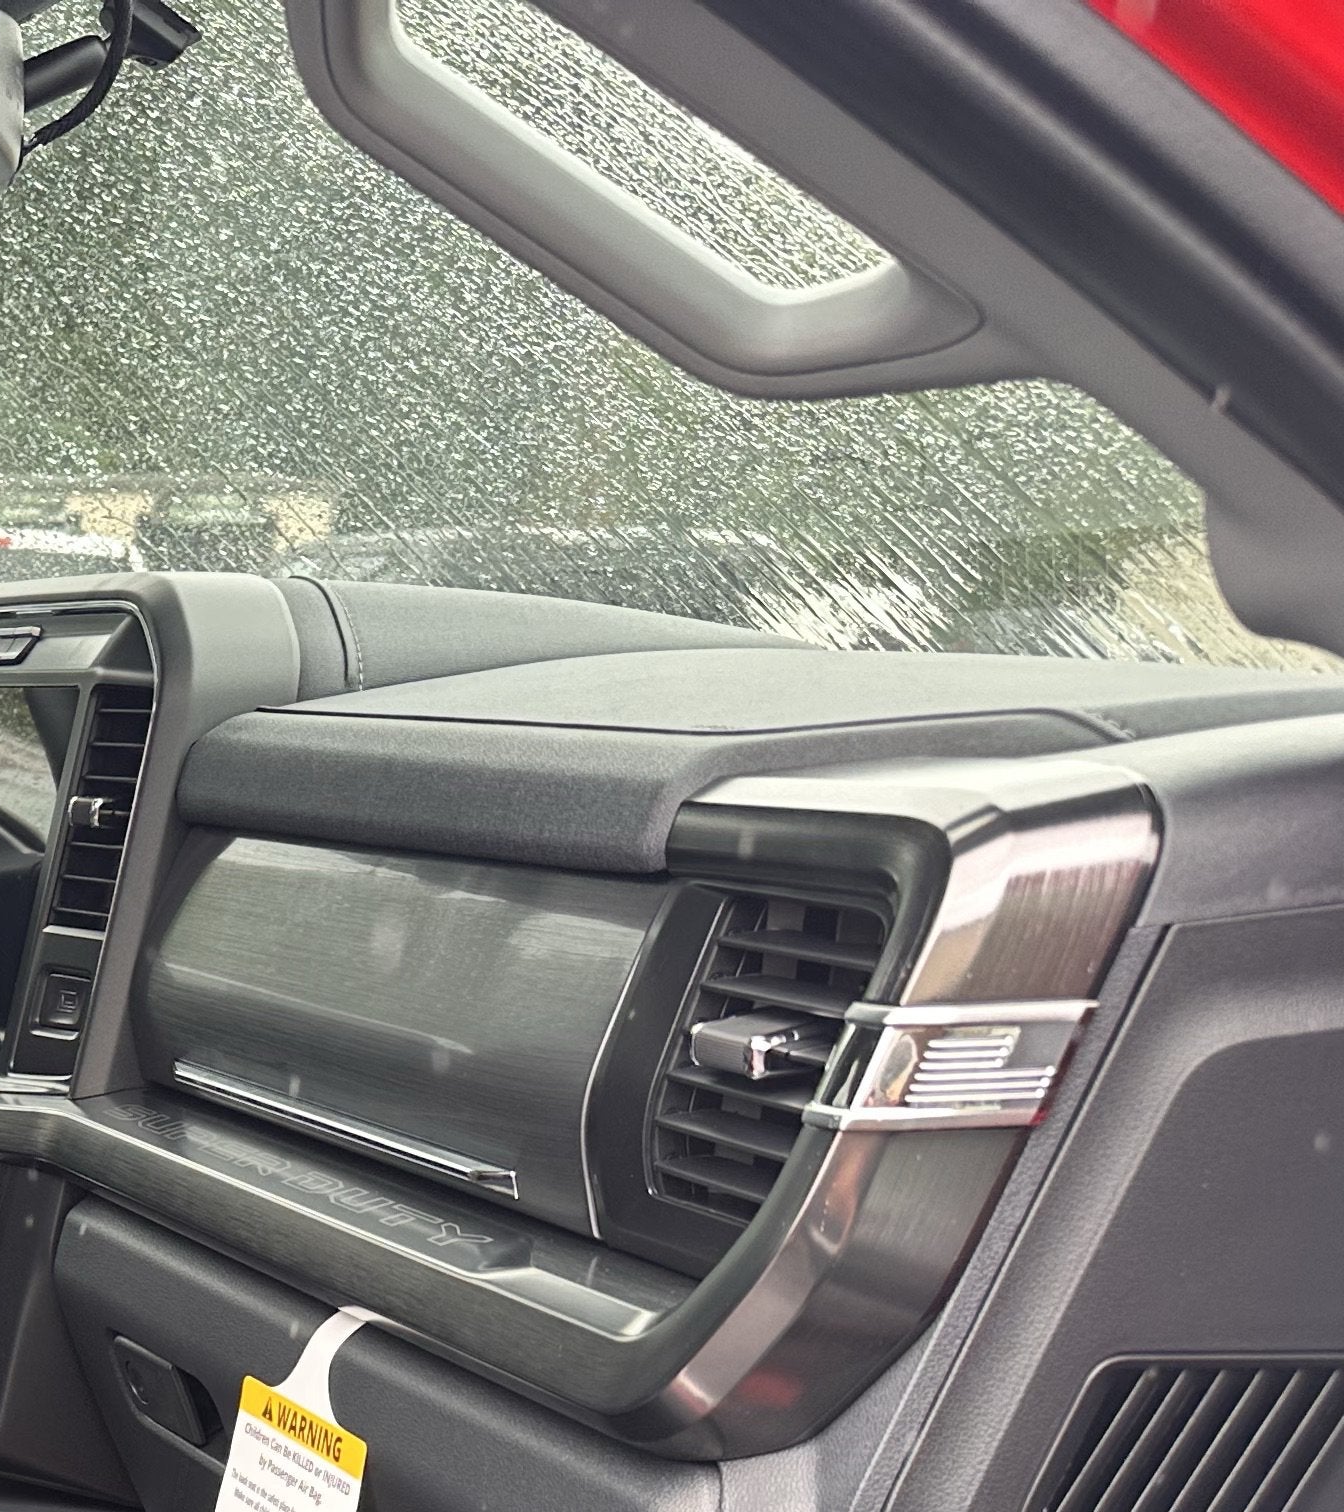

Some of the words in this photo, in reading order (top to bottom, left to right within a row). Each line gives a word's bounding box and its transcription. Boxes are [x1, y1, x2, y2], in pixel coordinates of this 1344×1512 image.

[103, 1104, 291, 1177] SUPER
[282, 1171, 494, 1246] DUTY
[244, 1422, 269, 1445] Children
[270, 1436, 283, 1453] Can
[283, 1445, 292, 1458] Be
[292, 1450, 313, 1473] KILLED
[314, 1467, 323, 1478] or
[322, 1470, 351, 1496] INJURED
[277, 1401, 343, 1462] WARNING
[258, 1453, 267, 1471] by
[268, 1460, 299, 1487] Passenger
[298, 1480, 310, 1494] Air
